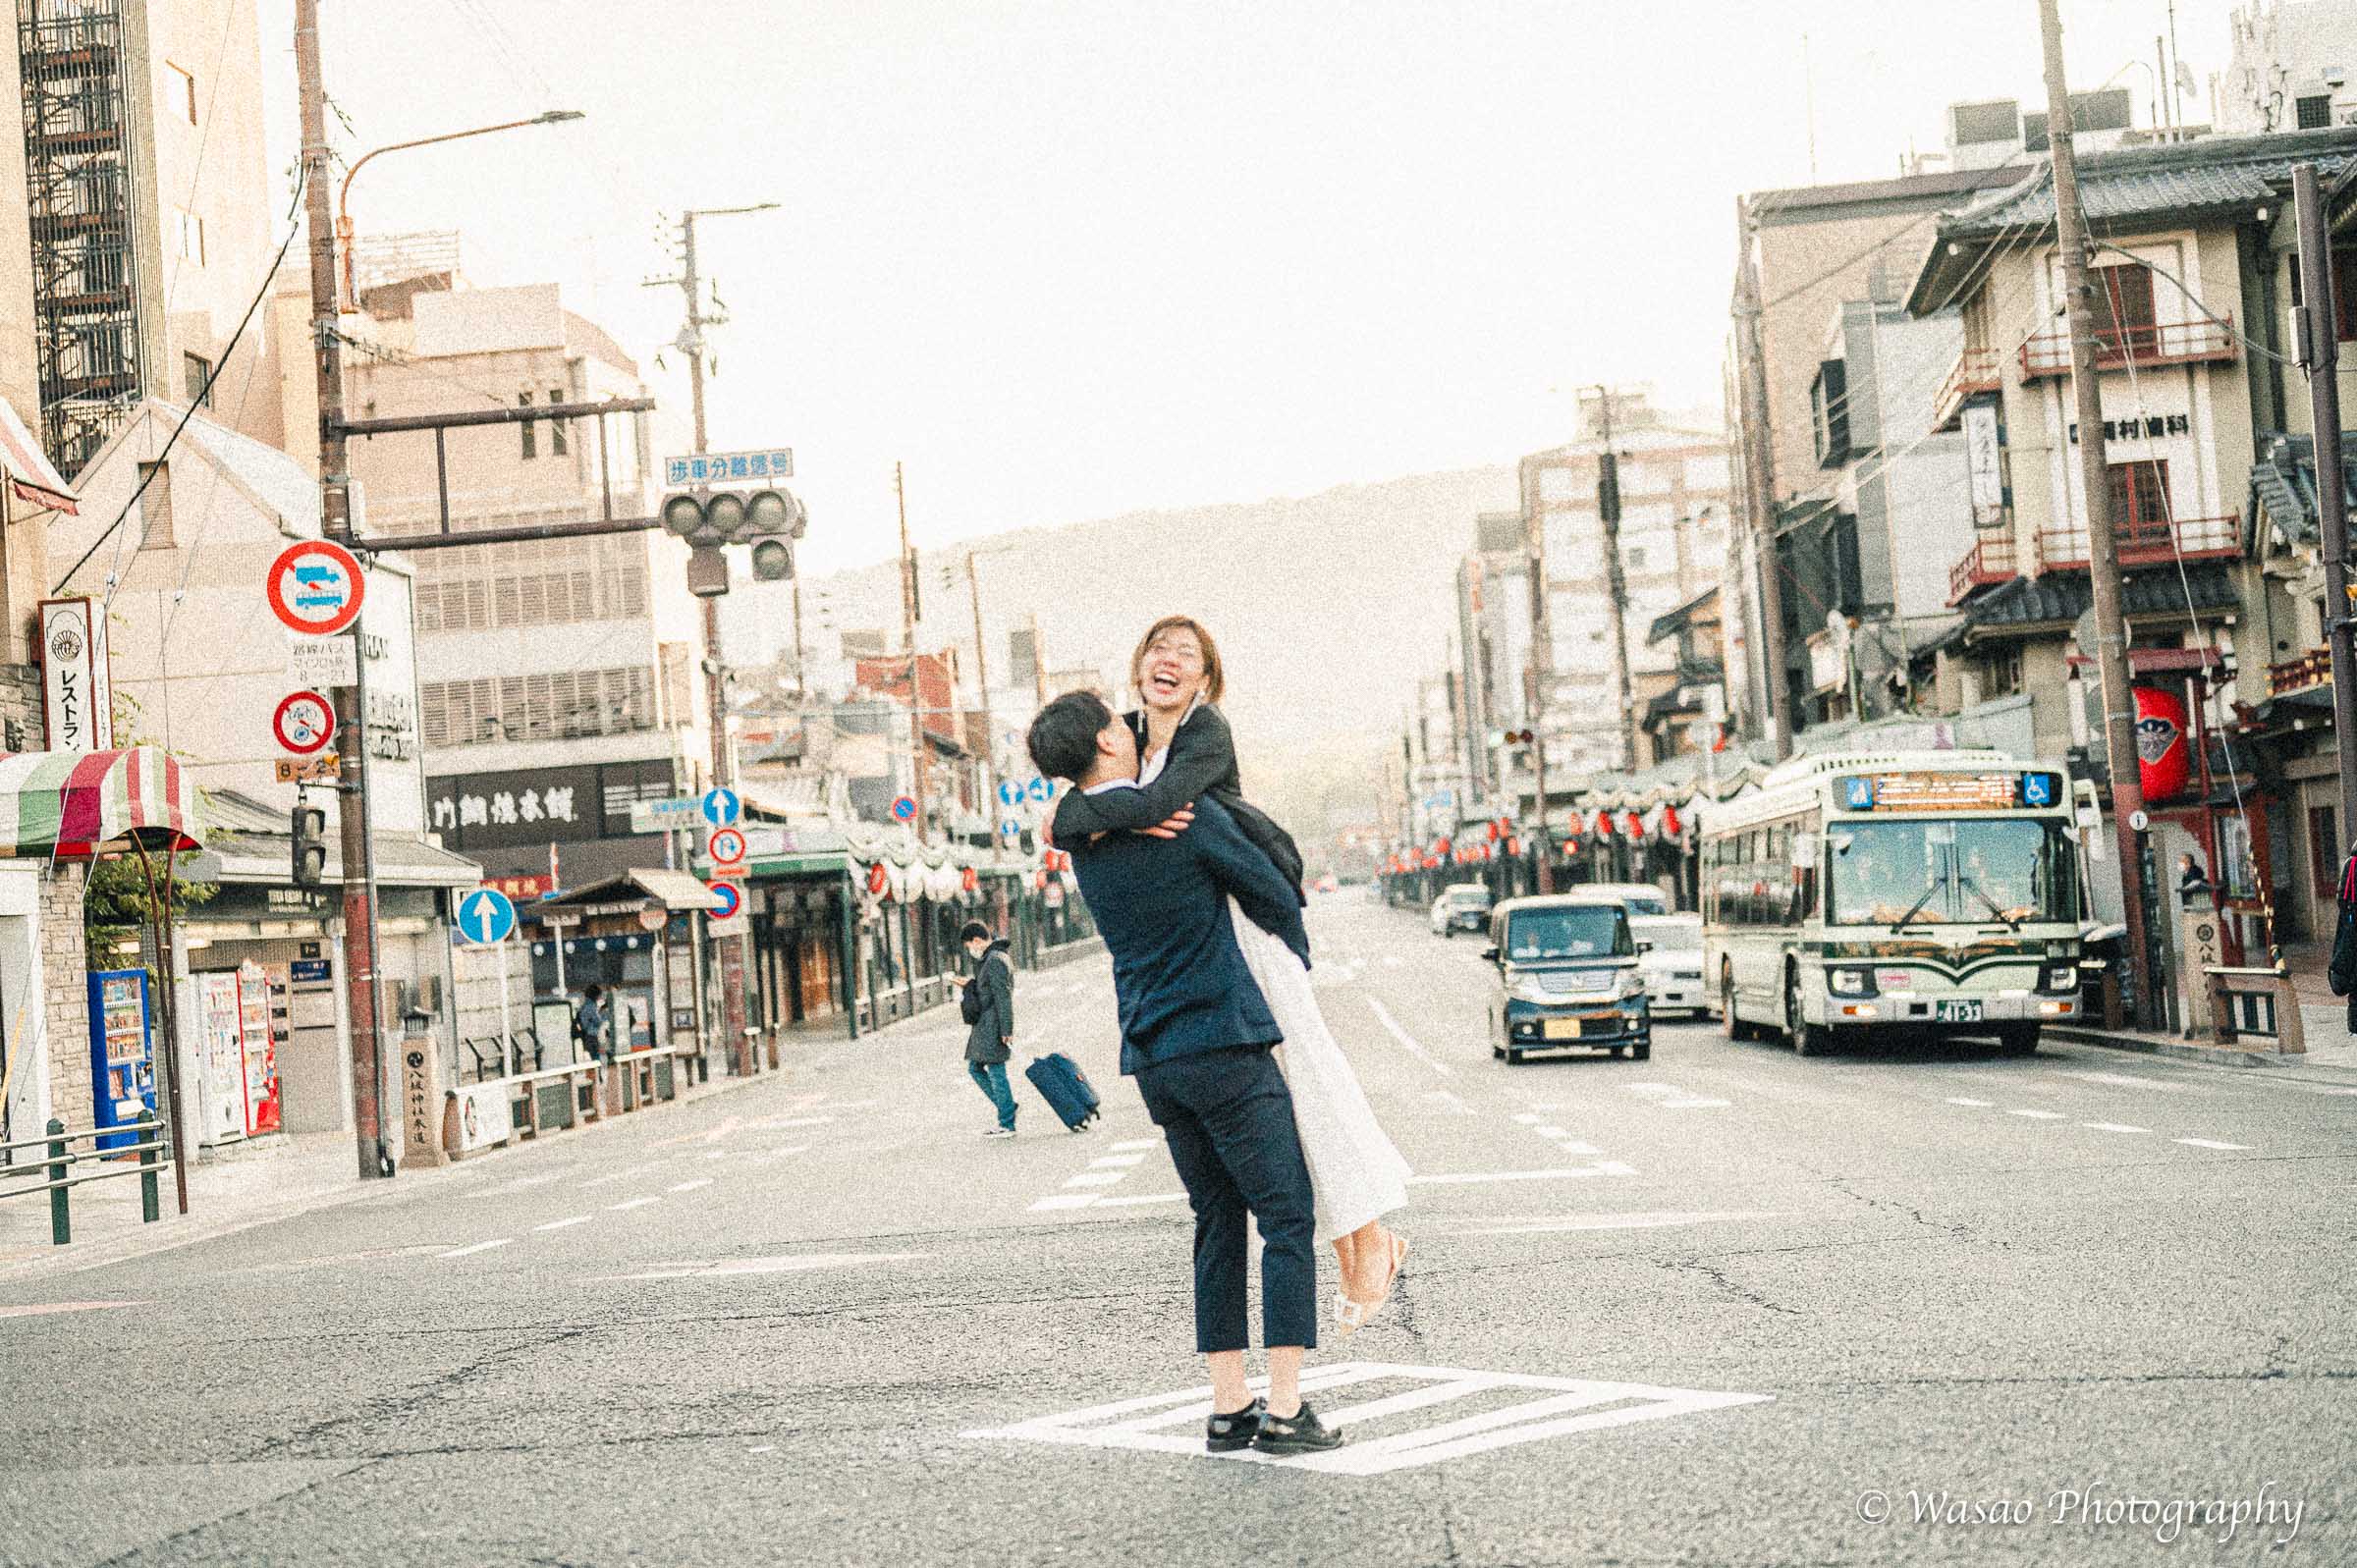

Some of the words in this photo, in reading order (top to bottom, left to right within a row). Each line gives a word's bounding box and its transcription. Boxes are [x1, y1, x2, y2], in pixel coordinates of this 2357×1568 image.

[671, 453, 787, 482] 歩車分離信号
[61, 670, 81, 752] レストラン
[425, 786, 574, 829] 門鯛焼本舗
